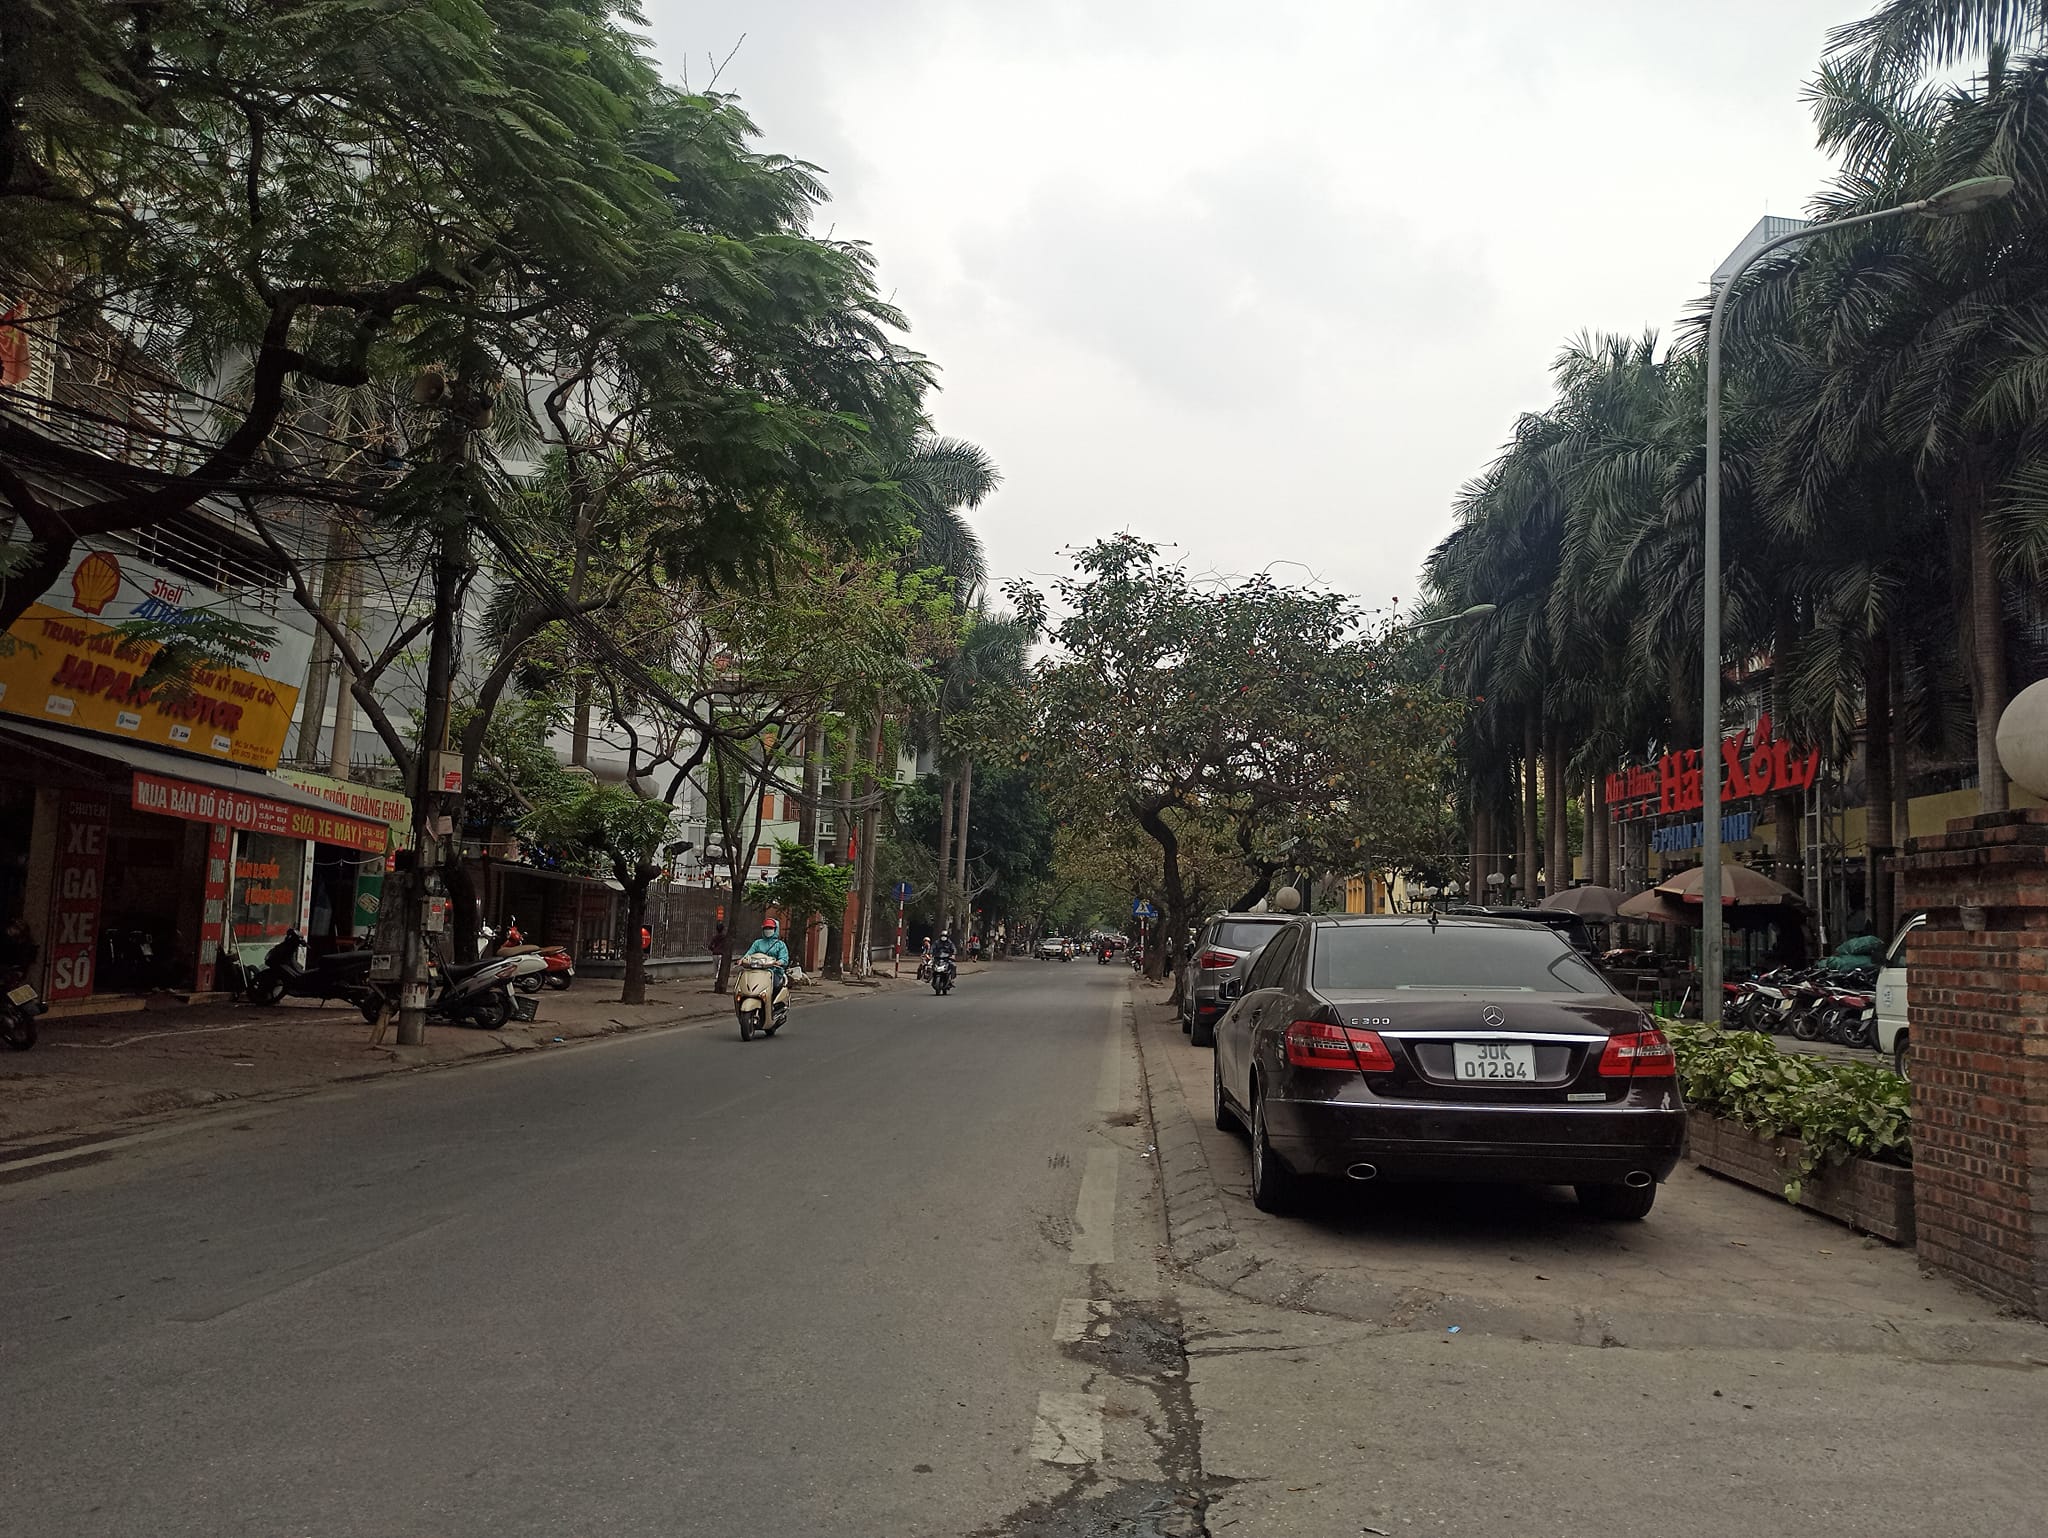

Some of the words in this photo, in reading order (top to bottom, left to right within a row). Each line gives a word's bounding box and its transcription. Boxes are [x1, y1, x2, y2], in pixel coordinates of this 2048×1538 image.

[151, 578, 184, 604] Shell
[138, 781, 168, 809] MUA
[170, 786, 198, 815] BÁN
[67, 823, 100, 856] XE
[292, 808, 315, 836] SỬA
[317, 819, 332, 839] XE
[334, 819, 358, 844] MÁY
[62, 866, 98, 899] GA
[58, 911, 95, 945] XE
[55, 943, 94, 991] SỐ
[1477, 1044, 1512, 1061] 30K
[1464, 1061, 1528, 1080] 012.84
